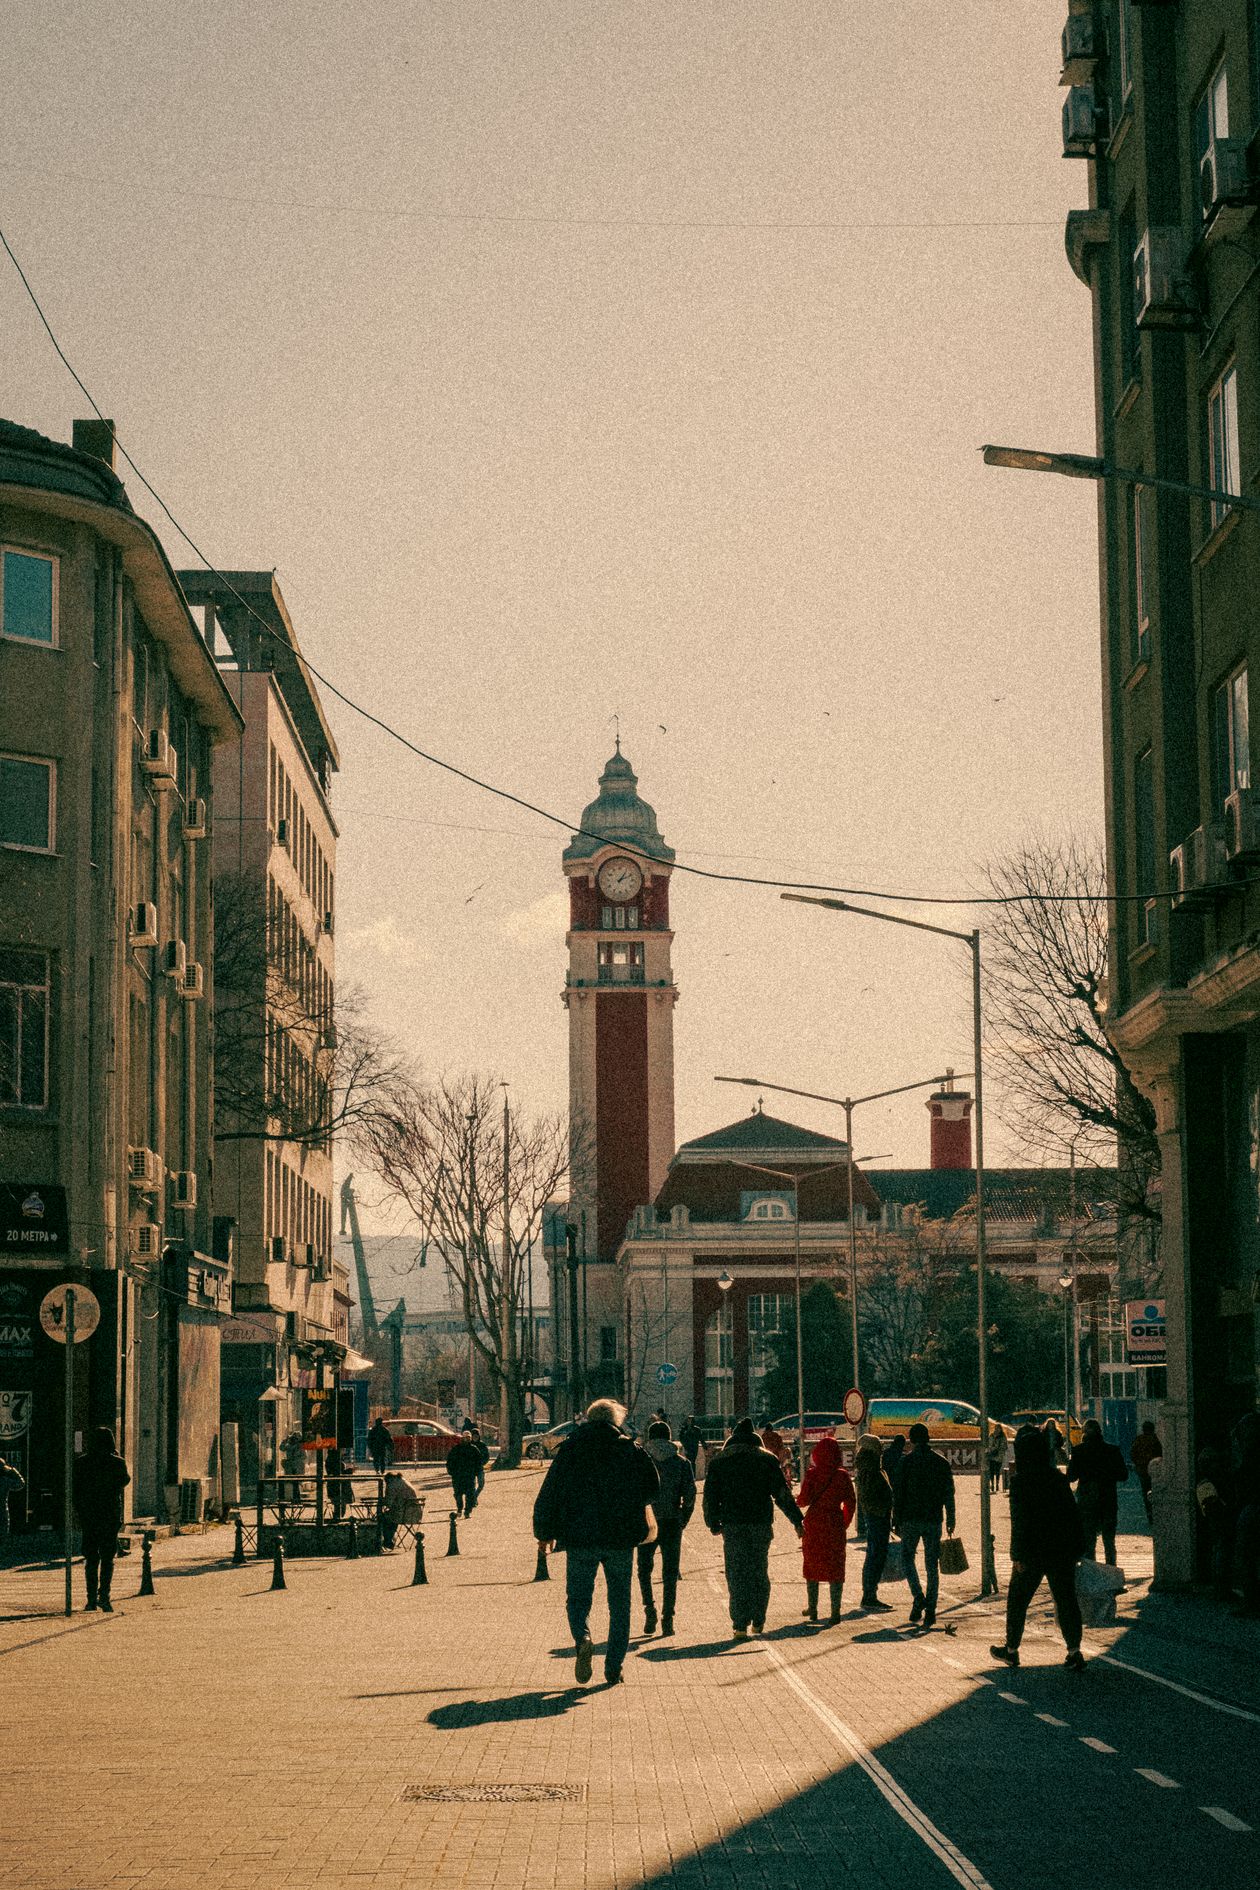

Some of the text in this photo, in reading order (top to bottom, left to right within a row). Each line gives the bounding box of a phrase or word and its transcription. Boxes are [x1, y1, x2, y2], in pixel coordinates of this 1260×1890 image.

[7, 1230, 49, 1241] 20 МЕТРА
[12, 1393, 29, 1422] 7
